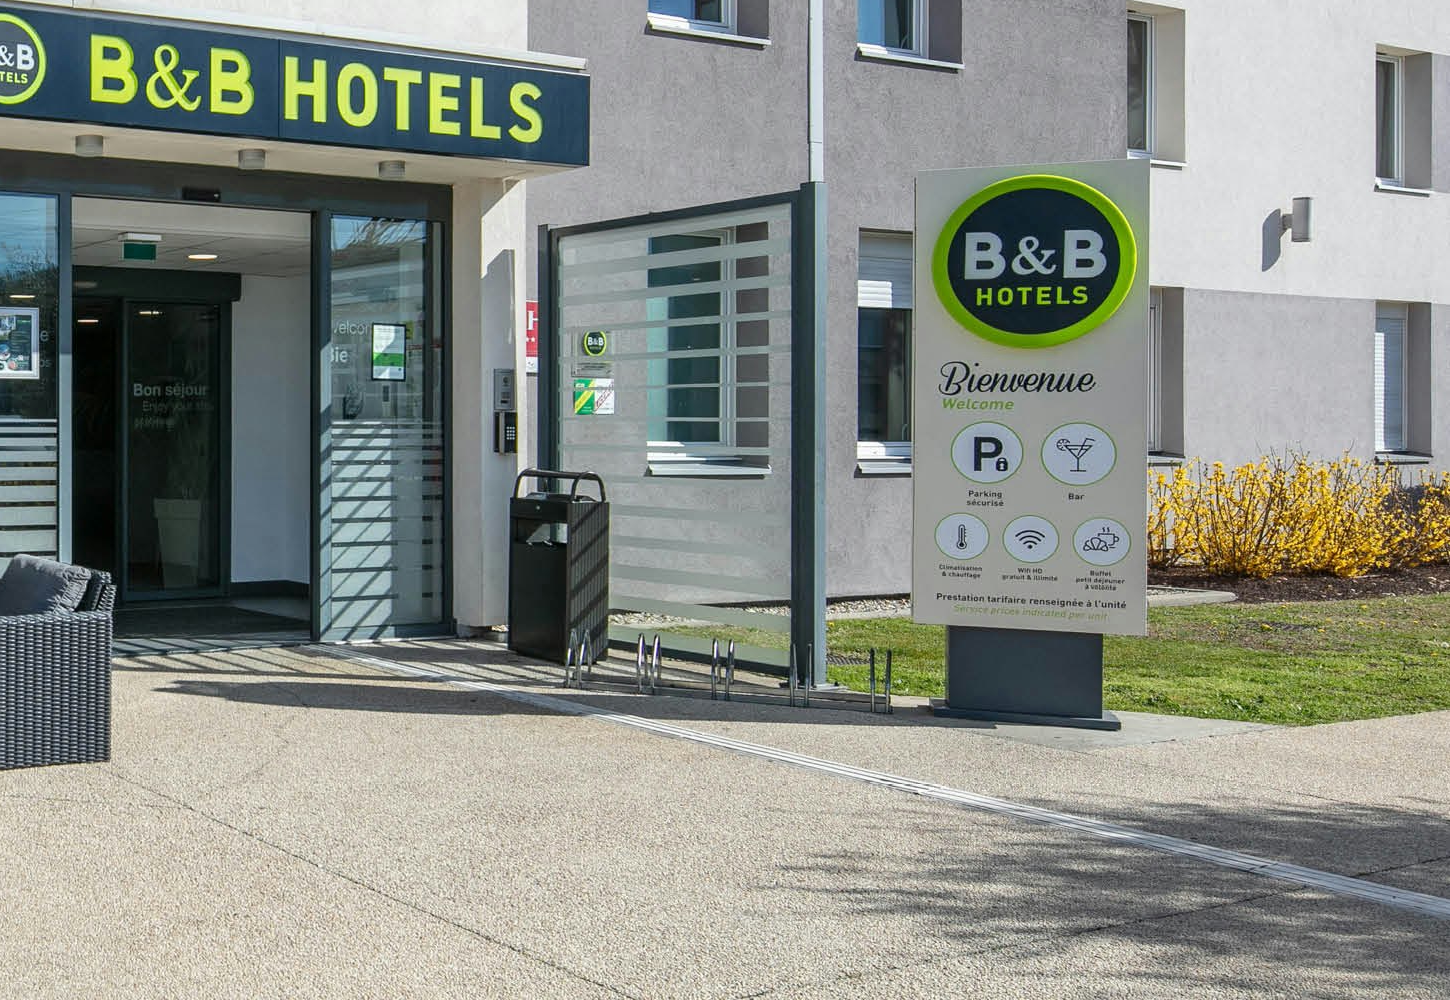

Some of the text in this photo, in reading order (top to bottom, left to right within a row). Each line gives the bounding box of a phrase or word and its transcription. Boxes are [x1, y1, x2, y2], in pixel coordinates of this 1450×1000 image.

[90, 34, 543, 144] B&B HOTELS
[964, 229, 1107, 280] B&B
[976, 286, 1088, 306] HOTELS
[587, 336, 604, 346] B&B
[938, 361, 1097, 396] Bienvenue
[133, 381, 208, 399] Bon séjour
[942, 397, 1015, 411] Welcome
[966, 498, 1004, 507] sécurisé
[968, 490, 1003, 499] Parking
[939, 564, 983, 572] Climatisation
[948, 571, 981, 579] chauffage
[936, 592, 1127, 610] Prestation tarifaire renseignée à l'unité
[954, 604, 1108, 621] Service prices indicated per unit
